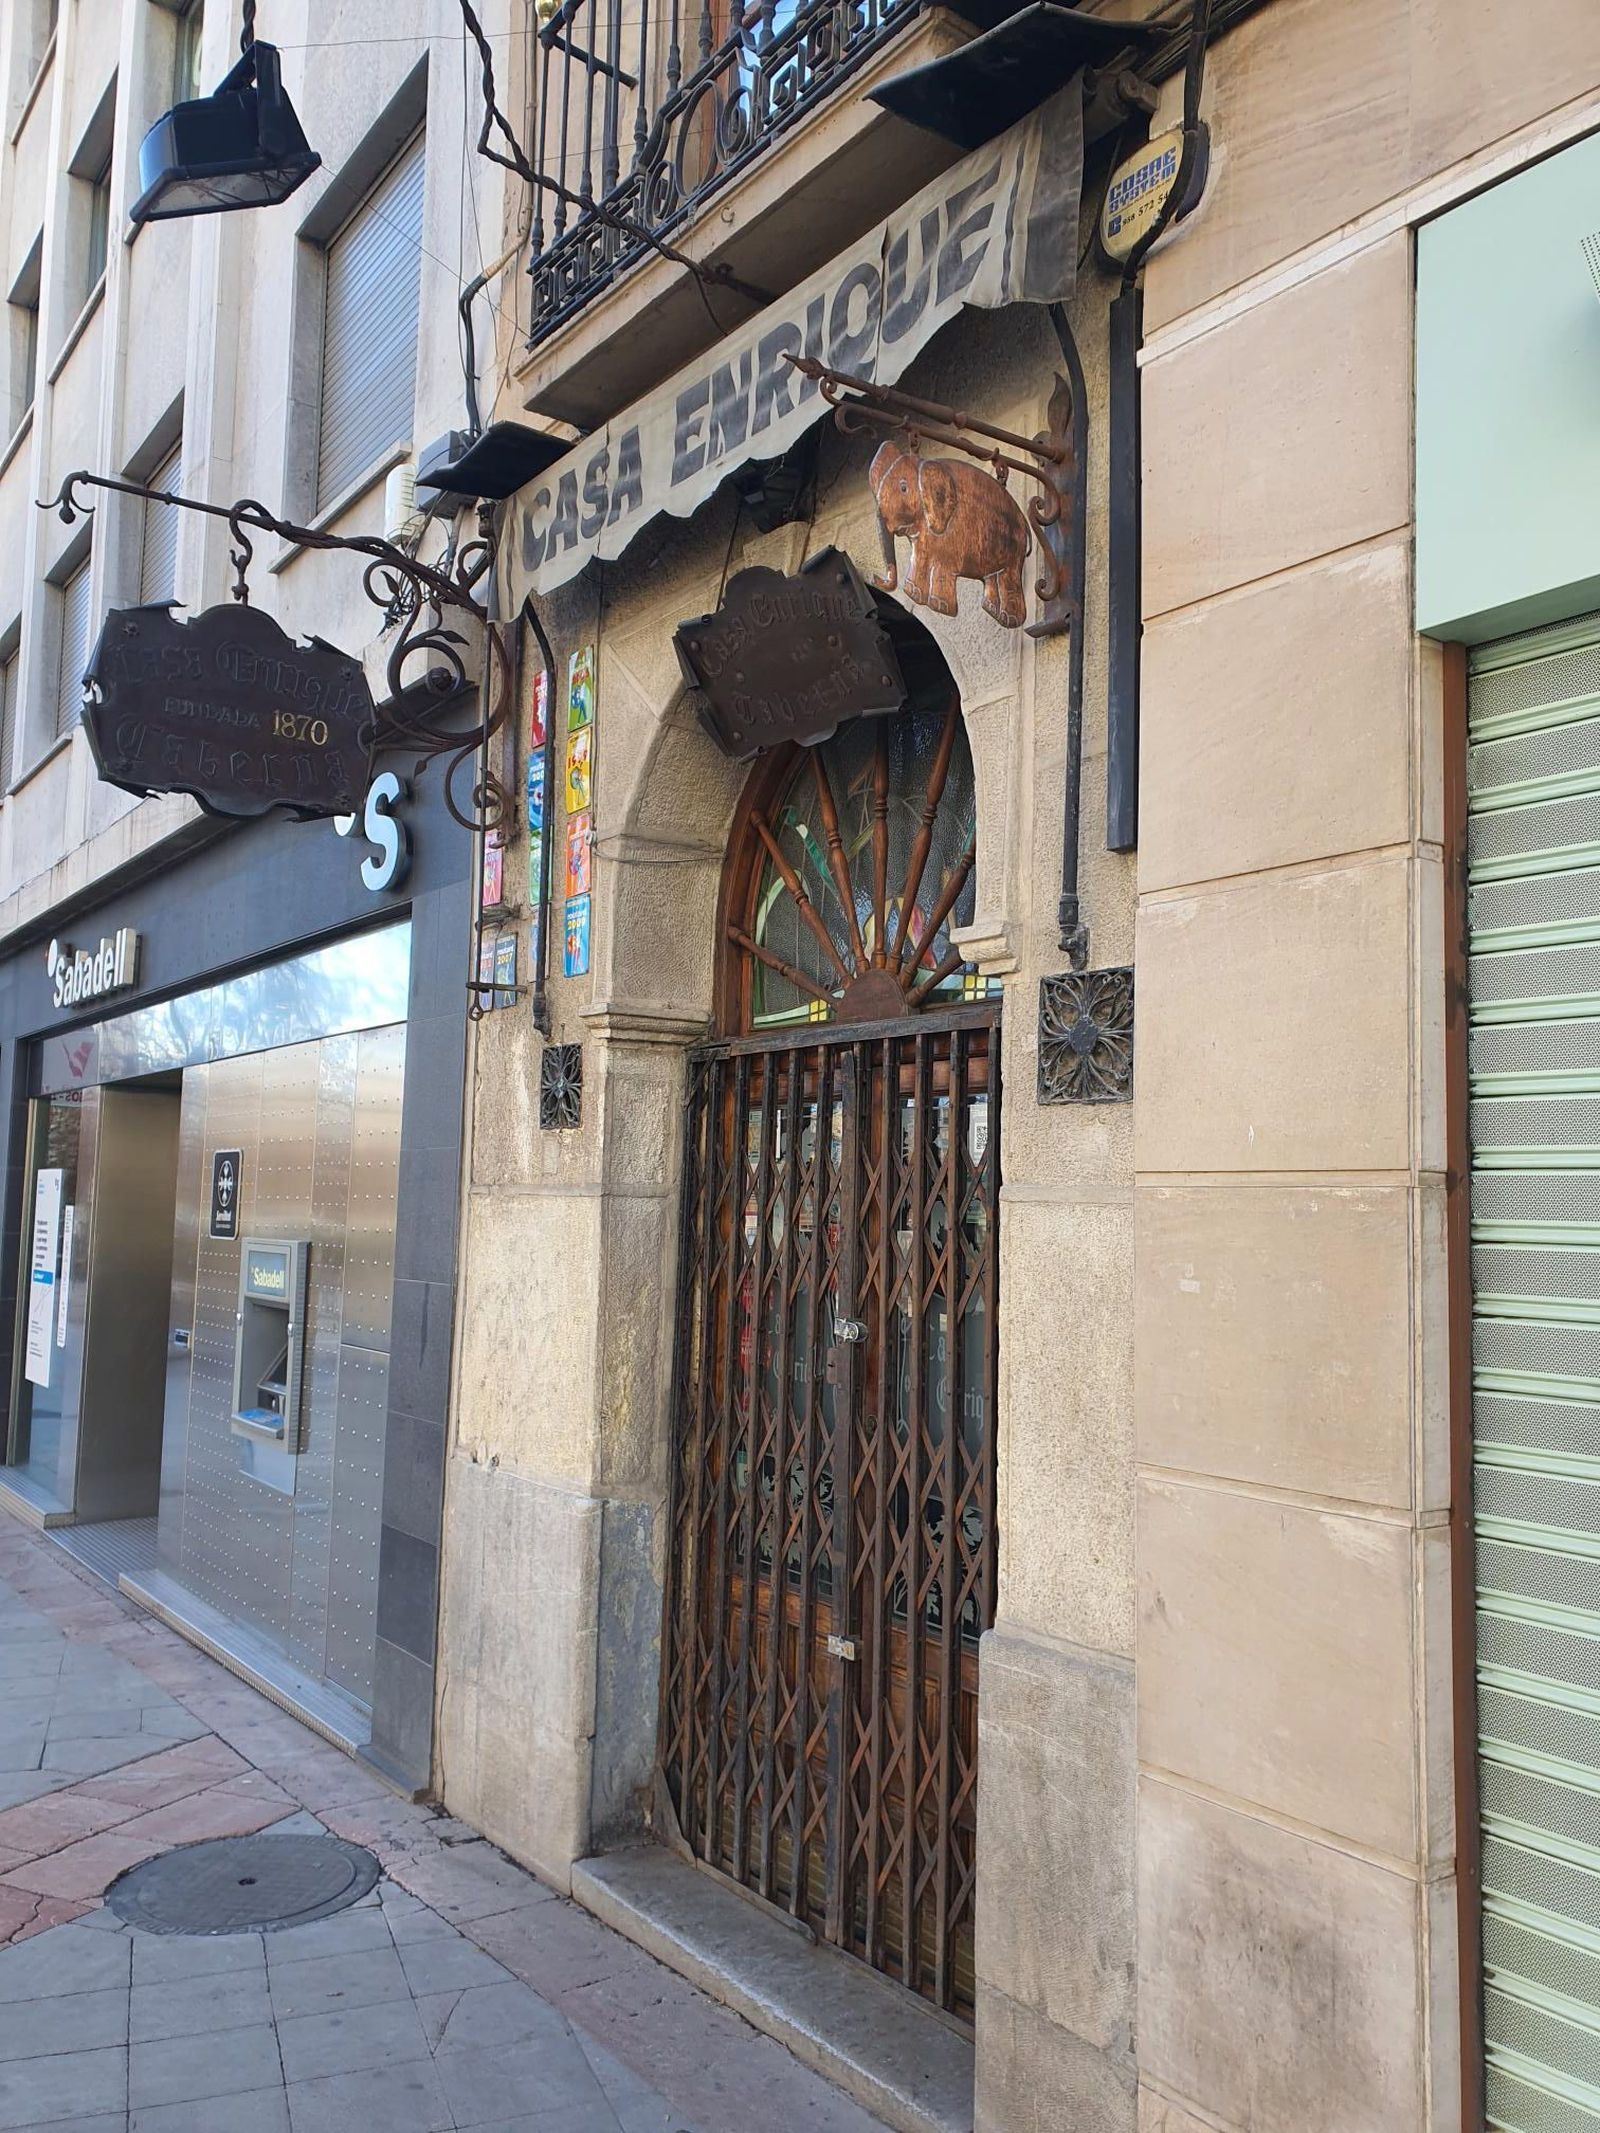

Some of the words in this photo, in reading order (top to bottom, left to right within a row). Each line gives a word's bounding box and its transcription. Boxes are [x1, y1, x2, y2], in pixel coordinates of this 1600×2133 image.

[521, 425, 643, 573] CASA
[669, 156, 1001, 487] ENRIQUE
[271, 707, 329, 747] 1870
[53, 927, 128, 1009] Sabadell
[253, 1267, 285, 1289] Sabadell
